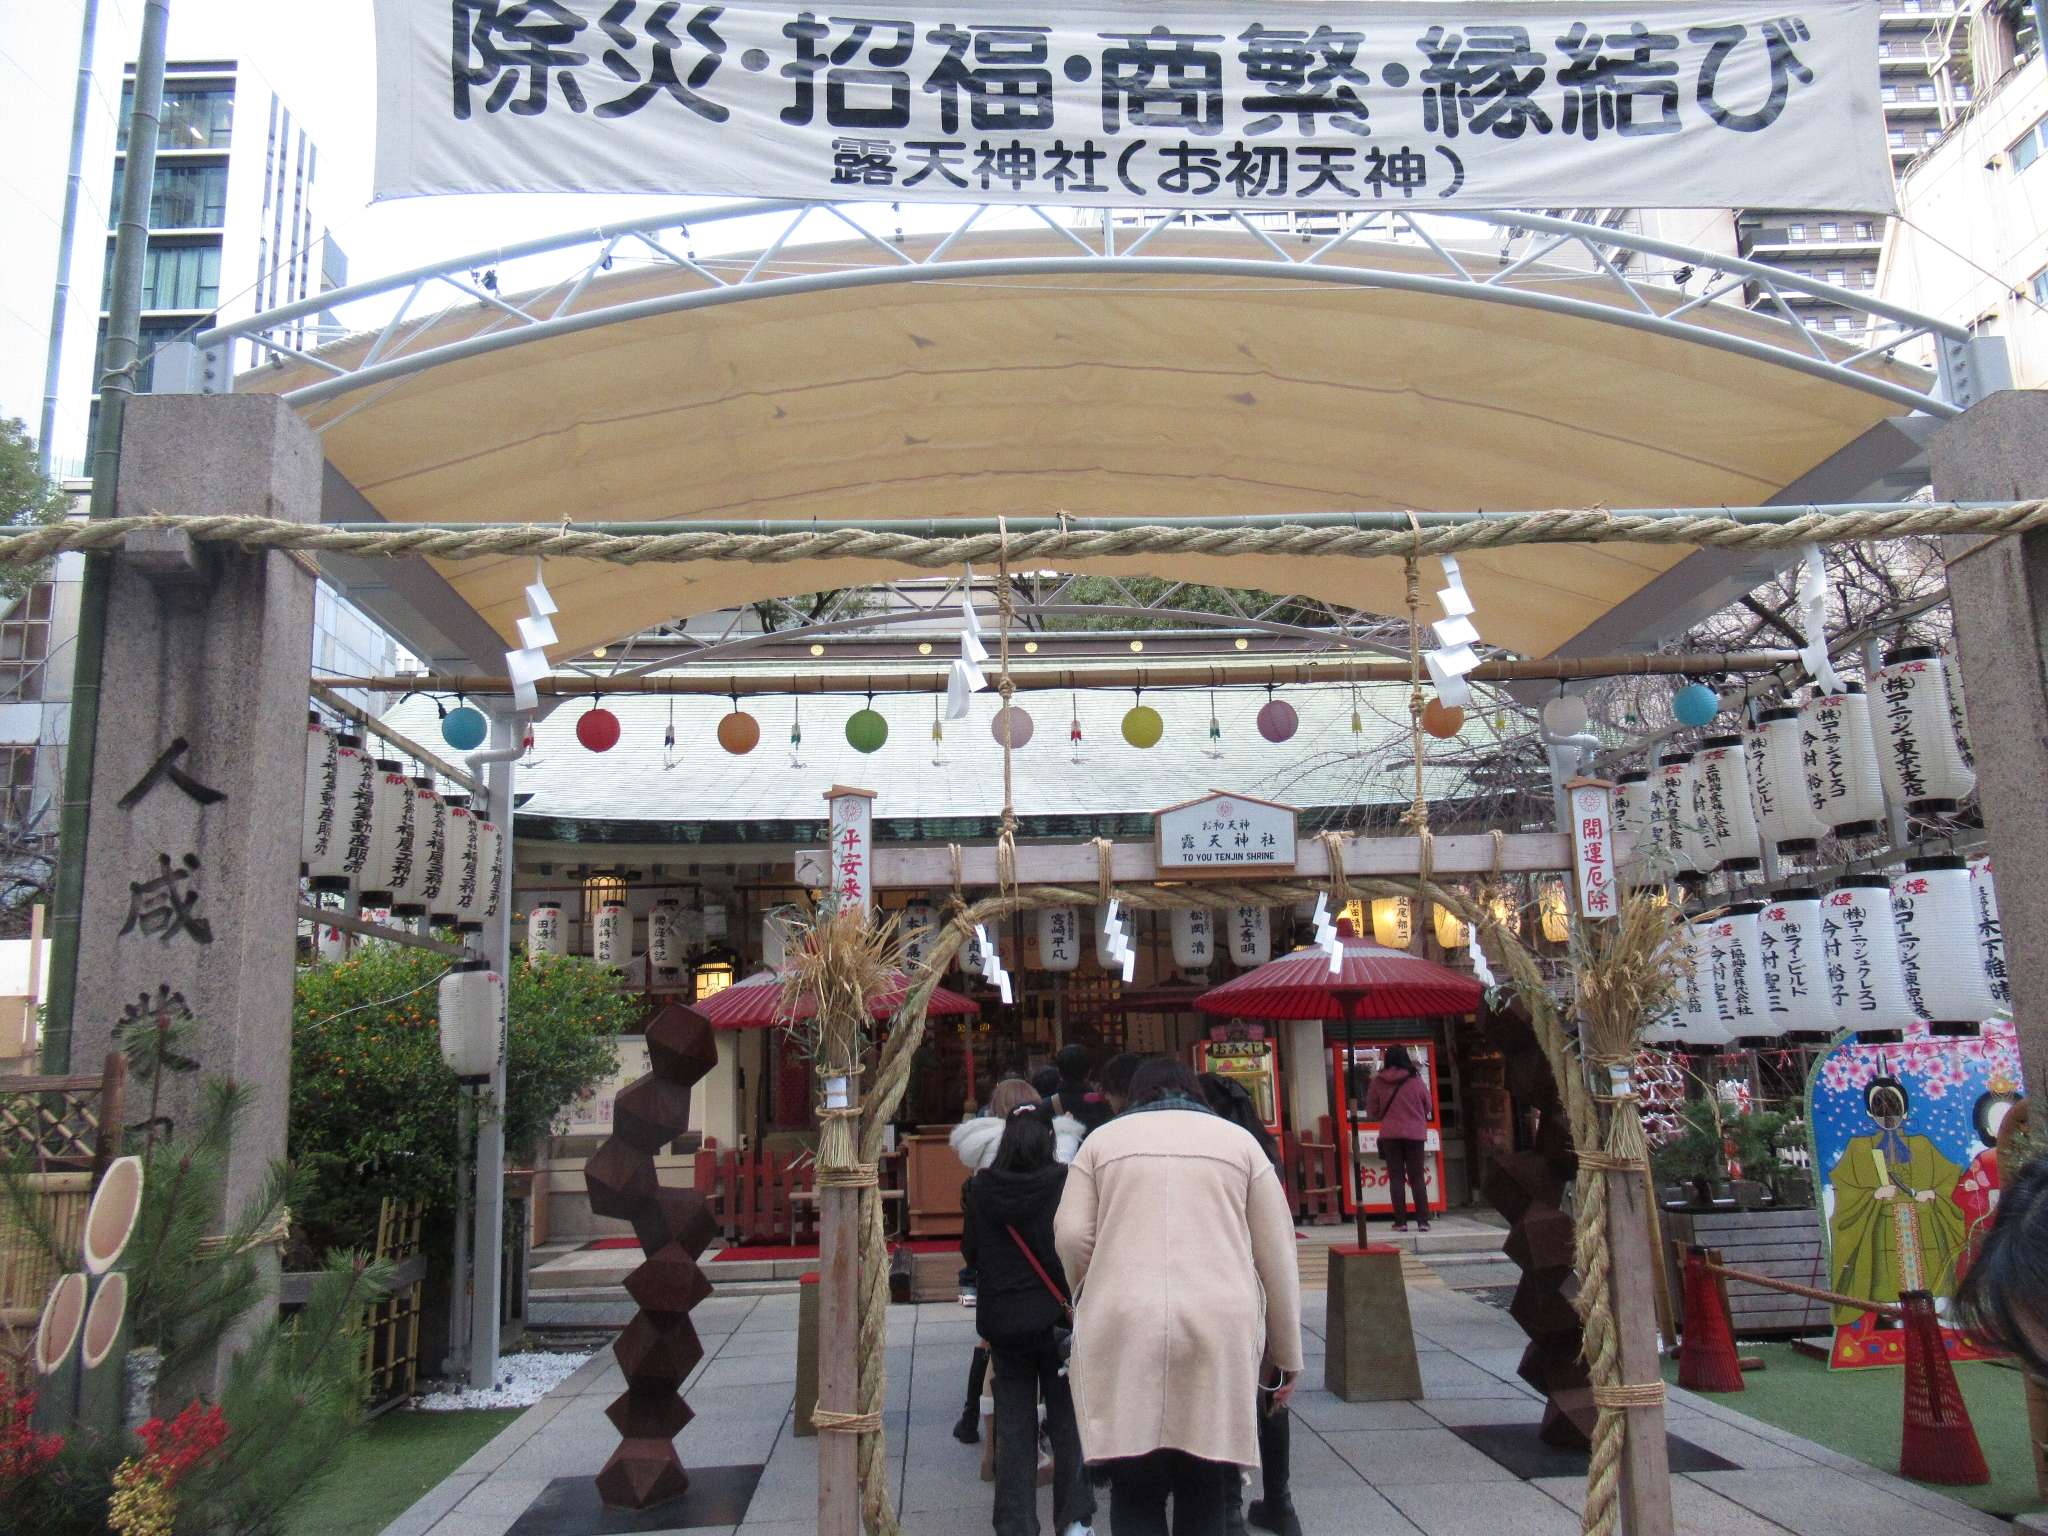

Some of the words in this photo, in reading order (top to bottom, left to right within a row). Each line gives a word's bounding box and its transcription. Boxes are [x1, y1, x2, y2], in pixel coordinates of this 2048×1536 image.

[1202, 819, 1250, 831] お初天神
[1181, 832, 1276, 849] 露天神社
[1183, 854, 1194, 862] TO
[1196, 853, 1212, 862] YOU
[1215, 853, 1244, 861] TENJIN
[1246, 852, 1275, 861] SHRINE
[1583, 818, 1609, 912] 開運厄除
[839, 828, 864, 918] 平安来
